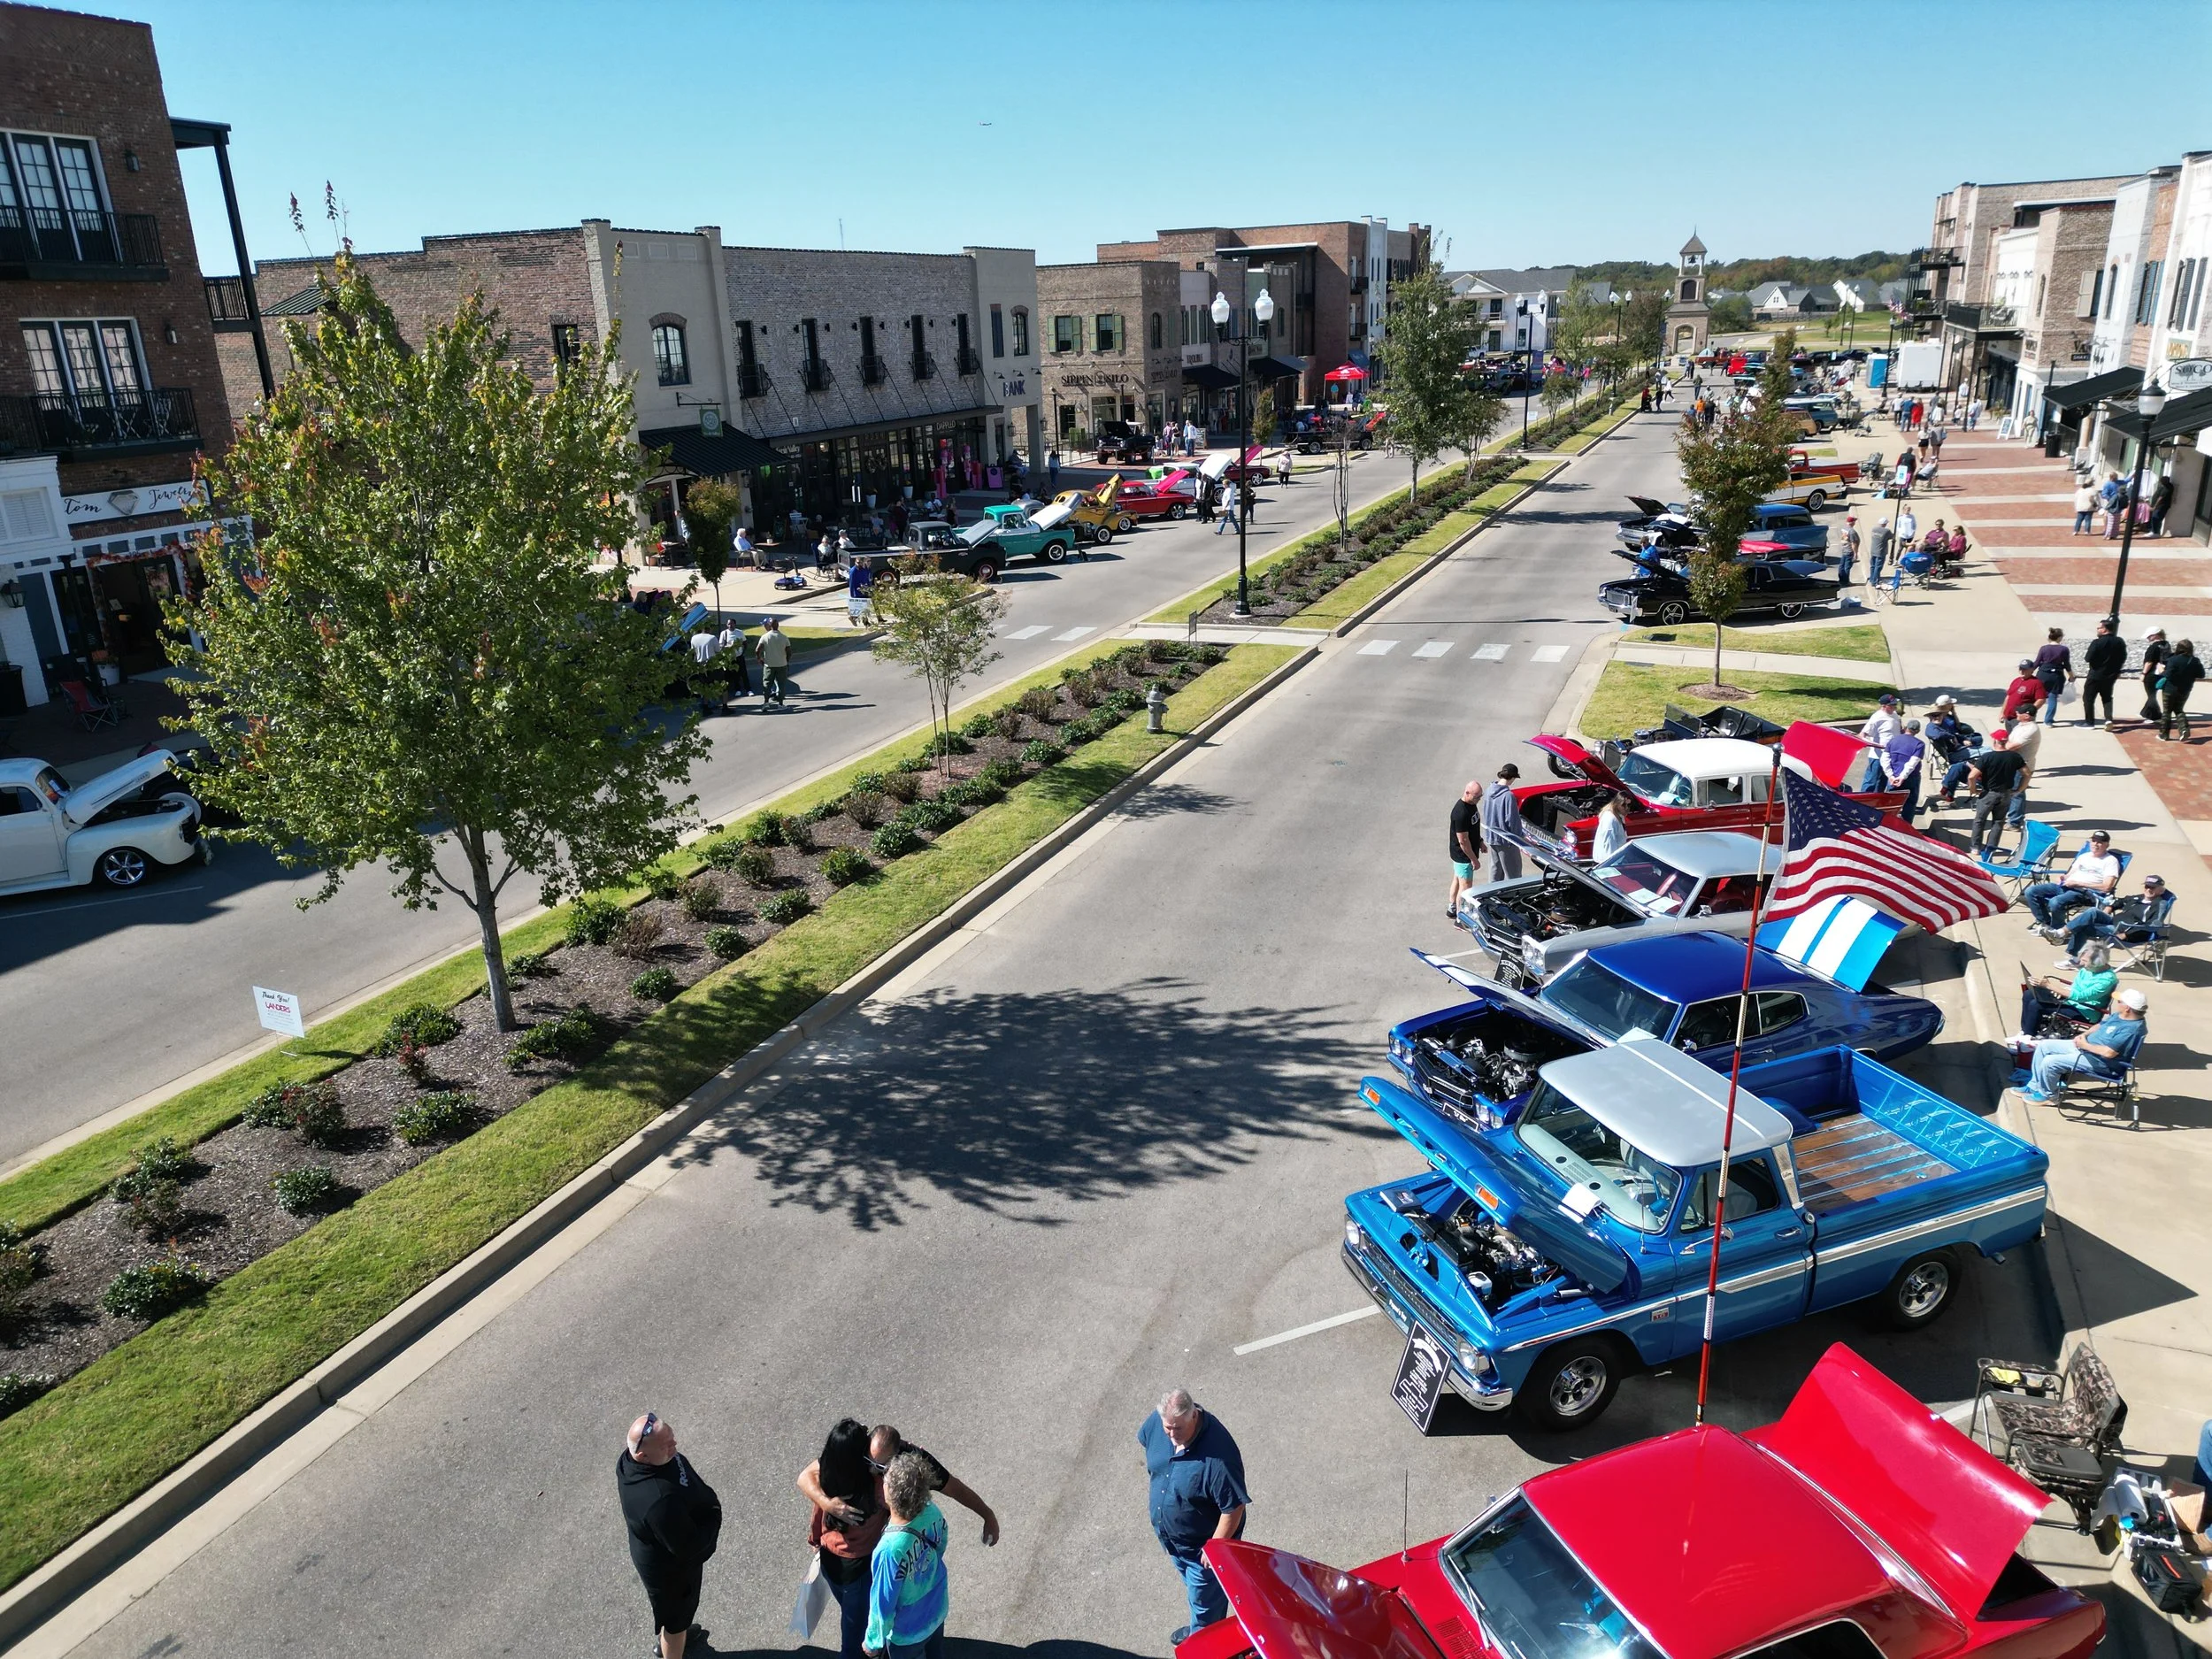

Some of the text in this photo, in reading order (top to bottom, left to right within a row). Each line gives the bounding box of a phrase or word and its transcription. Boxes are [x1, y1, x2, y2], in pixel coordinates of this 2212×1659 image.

[2176, 364, 2212, 374] SOCO
[1105, 373, 1129, 383] SILO
[1002, 380, 1026, 397] BANK
[262, 991, 290, 1003] Thank You!
[265, 1002, 291, 1013] LANDERS
